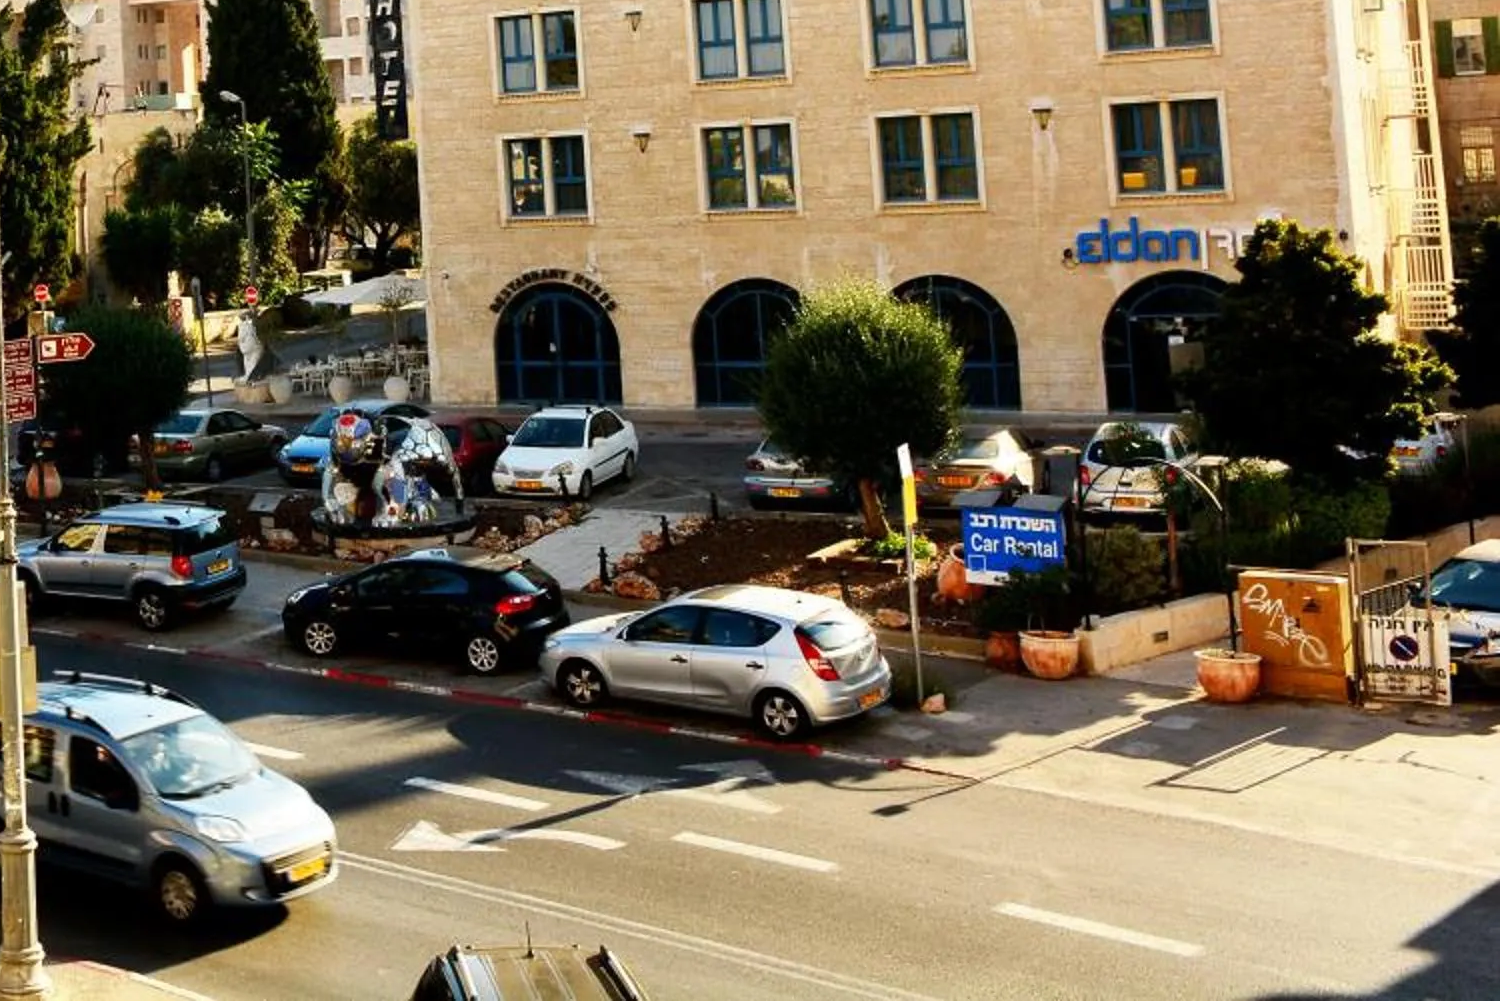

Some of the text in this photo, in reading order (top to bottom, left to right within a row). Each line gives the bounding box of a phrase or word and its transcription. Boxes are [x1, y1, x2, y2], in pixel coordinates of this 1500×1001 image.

[1076, 216, 1200, 263] eldan
[489, 269, 568, 313] RESTAURANT
[969, 512, 1057, 533] השכרת רכב
[971, 532, 1059, 558] Car Rental
